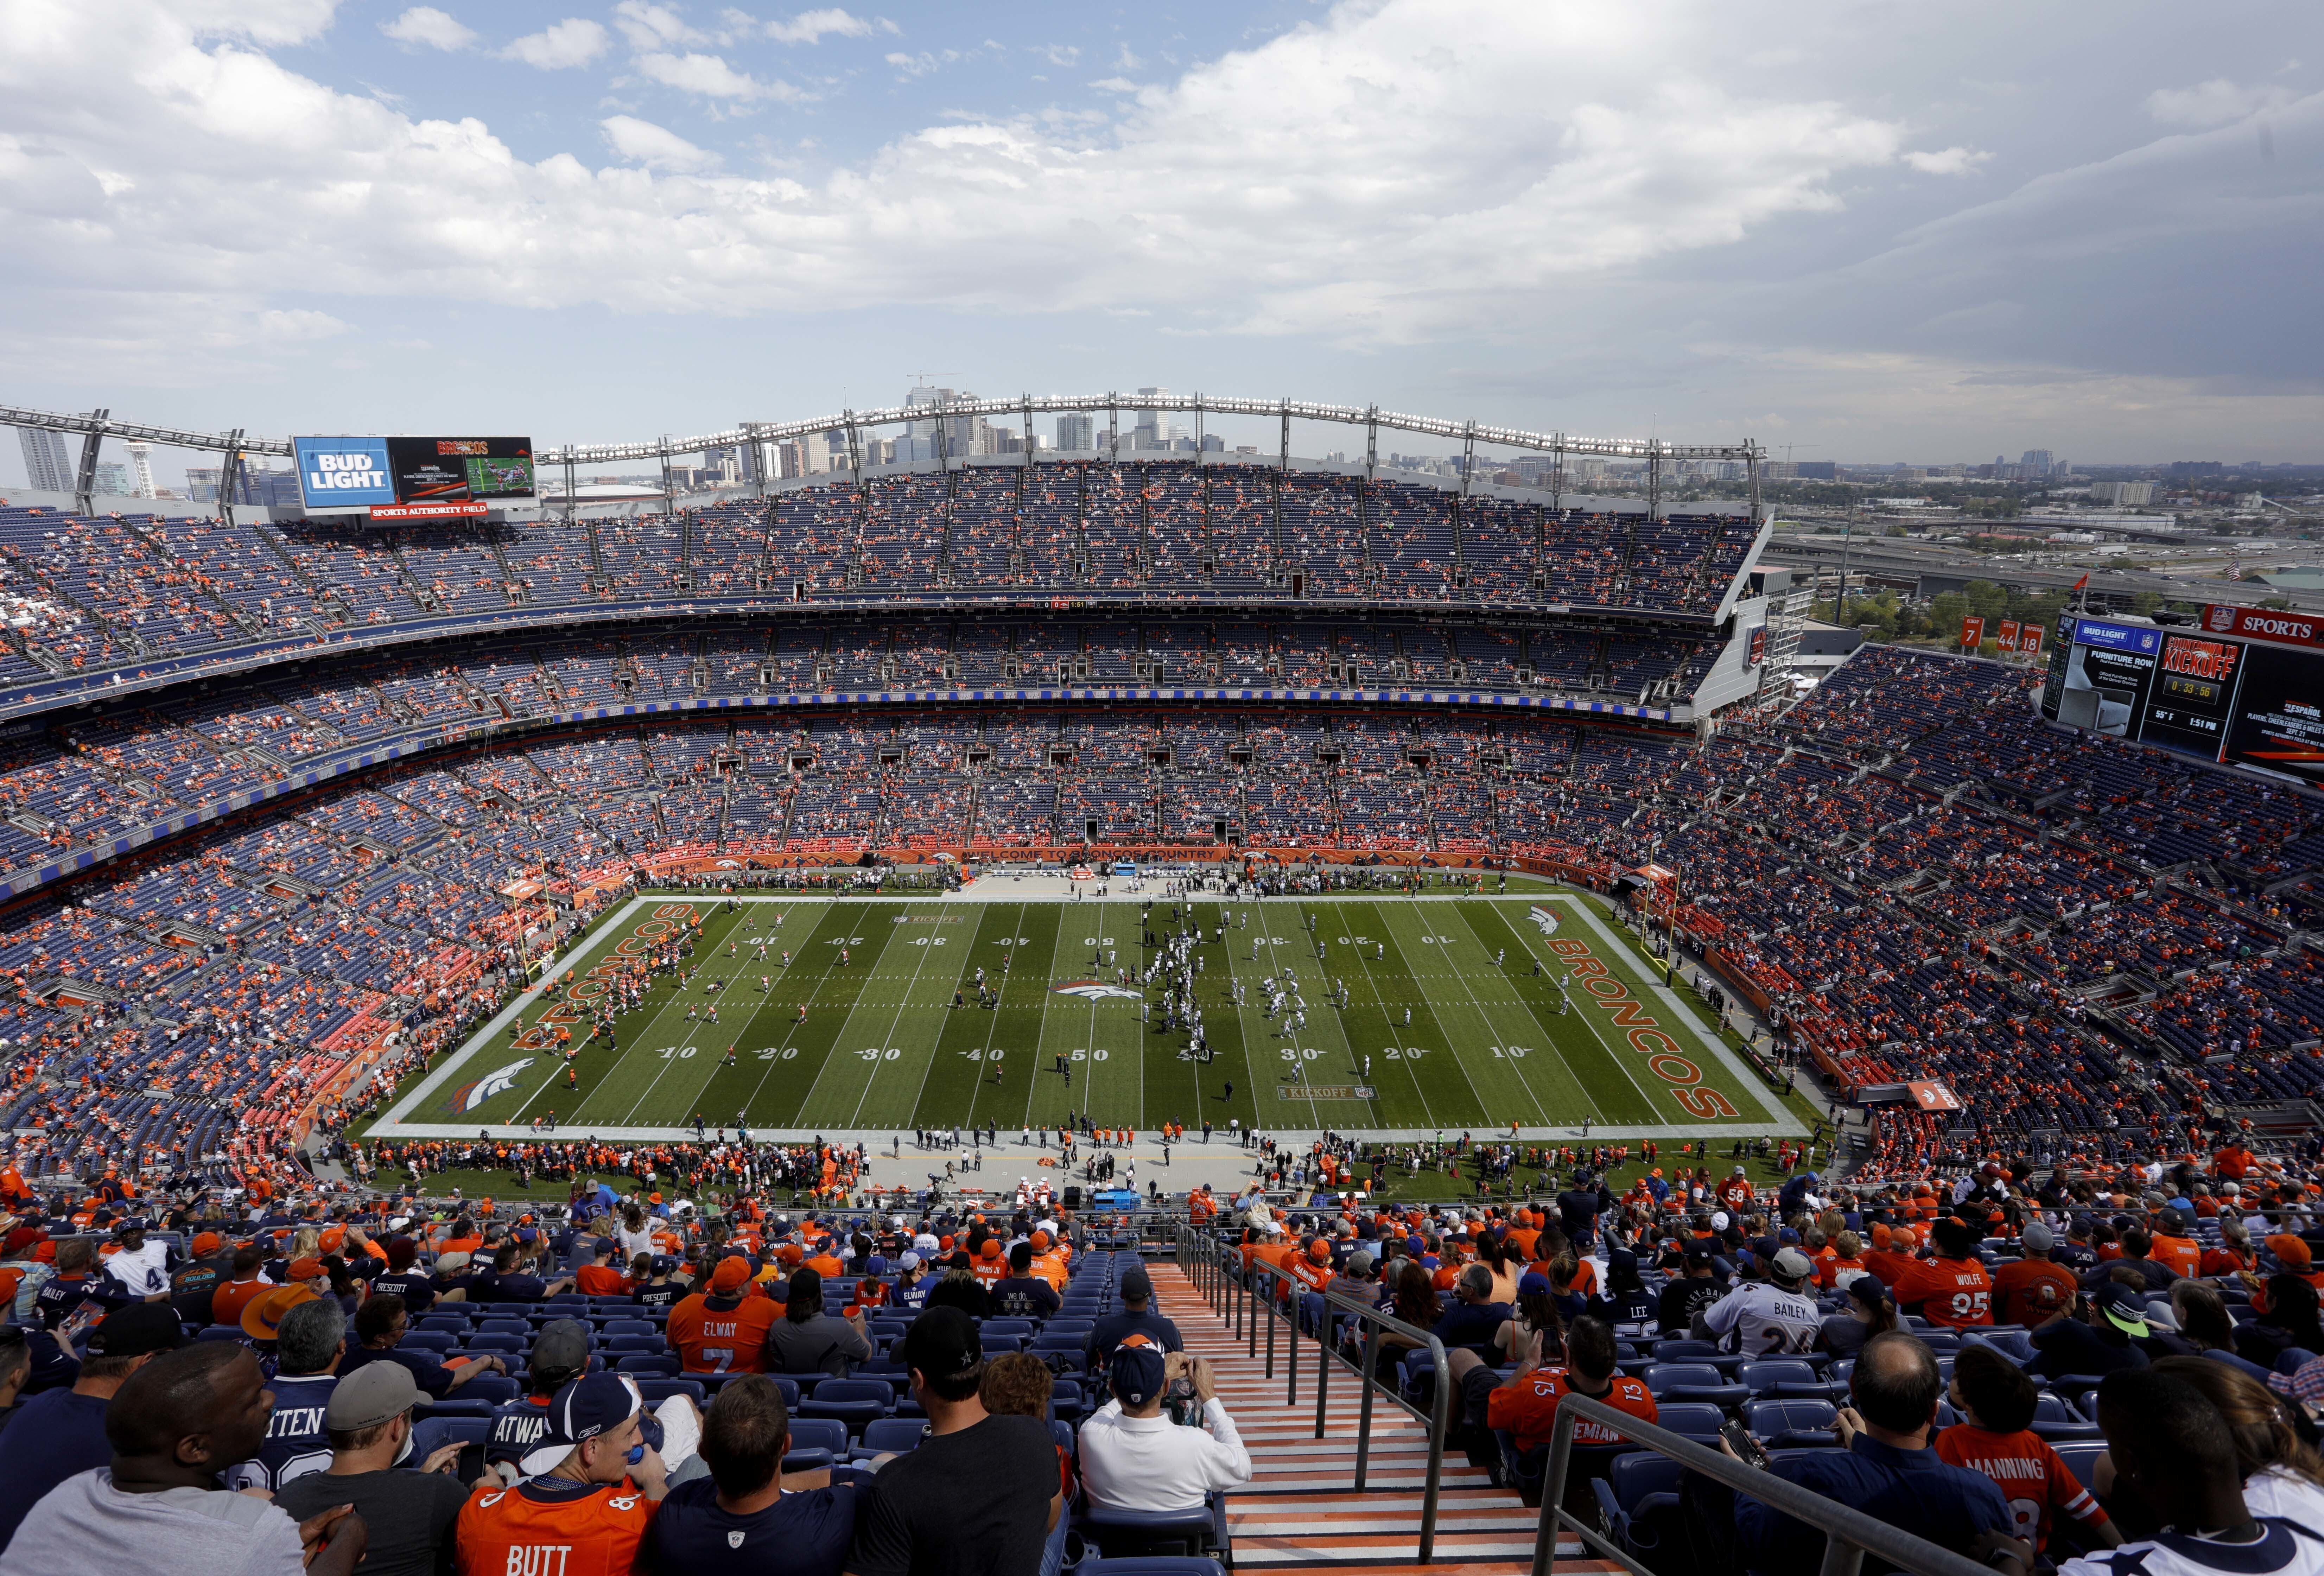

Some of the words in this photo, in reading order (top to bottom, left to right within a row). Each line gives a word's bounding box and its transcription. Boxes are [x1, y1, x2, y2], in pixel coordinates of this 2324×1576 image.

[318, 454, 373, 471] BUD
[311, 471, 384, 489] LIGHT
[408, 507, 461, 515] AUTHORITY
[2083, 627, 2101, 635] BUD
[2101, 629, 2126, 640] LIGHT
[2243, 617, 2312, 638] SPORTS
[1966, 630, 1975, 641] 7
[1998, 634, 2014, 647] 44
[316, 646, 337, 654] JACKSON
[2024, 637, 2037, 651] 18
[2167, 636, 2223, 656] COUNTDOWN
[2225, 645, 2239, 658] TO
[2091, 650, 2133, 664] FURNITURE
[2134, 658, 2153, 667] ROW
[2161, 648, 2235, 681] KICKOFF
[115, 686, 133, 694] ELWAY
[2291, 705, 2321, 717] ESPAÑOL
[2190, 718, 2204, 728] 1:51
[2205, 721, 2217, 731] PM
[2247, 712, 2268, 723] PLAYERS,
[2268, 717, 2302, 730] CHEERLEADERS
[2307, 725, 2322, 734] MILES
[2275, 732, 2294, 741] AUTHORITY
[969, 851, 1043, 859] WELCOME
[1047, 851, 1066, 859] TO
[657, 861, 702, 873] BRONCOS
[1529, 862, 1582, 880] ELEVATION
[1651, 864, 1674, 877] GEICO
[749, 937, 778, 945] 10
[832, 937, 864, 945] 20
[999, 938, 1030, 946] 40
[1085, 938, 1115, 946] 50
[1253, 937, 1284, 945] 30
[1338, 936, 1370, 945] 20
[1421, 936, 1451, 944] 10
[509, 903, 693, 1050] BRONCOS
[1719, 959, 1755, 996] BRONCOS
[1544, 938, 1741, 1118] BRONCOS
[660, 1047, 697, 1059] 10
[757, 1048, 798, 1060] 20
[862, 1049, 901, 1060] 30
[966, 1049, 1004, 1061] 40
[1071, 1049, 1109, 1061] 50
[1176, 1049, 1209, 1061] 40
[1281, 1048, 1319, 1060] 30
[1384, 1048, 1422, 1059] 20
[1490, 1046, 1525, 1058] 10
[1290, 1088, 1346, 1098] KICKOFF
[1934, 1082, 1959, 1108] GEICO
[1728, 1189, 1744, 1202] 58
[1193, 1202, 1206, 1214] 95
[2177, 1247, 2196, 1255] SPARKY
[473, 1254, 494, 1264] MANNING
[1923, 1258, 1938, 1266] 95
[976, 1265, 992, 1273] HARRIS
[1294, 1264, 1318, 1285] MANNING
[145, 1267, 165, 1293] 4
[1955, 1272, 1983, 1286] WOLFE
[81, 1280, 101, 1293] 24
[375, 1282, 407, 1293] PRESCOTT
[42, 1286, 66, 1302] BAILEY
[643, 1292, 671, 1302] PRESCOTT
[903, 1289, 926, 1300] ELWAY
[1018, 1291, 1027, 1300] do.
[1380, 1301, 1394, 1315] 18
[1774, 1302, 1807, 1319] BAILEY
[1951, 1291, 1989, 1320] 95
[1630, 1306, 1647, 1318] LEE
[704, 1322, 736, 1337] ELWAY
[1761, 1327, 1814, 1354] 24
[703, 1348, 734, 1373] 7
[1534, 1380, 1555, 1396] 13
[1622, 1384, 1643, 1402] 13
[357, 1415, 386, 1425] OAKLEY
[1966, 1458, 2045, 1480] MANNING
[506, 1545, 572, 1576] BUTT
